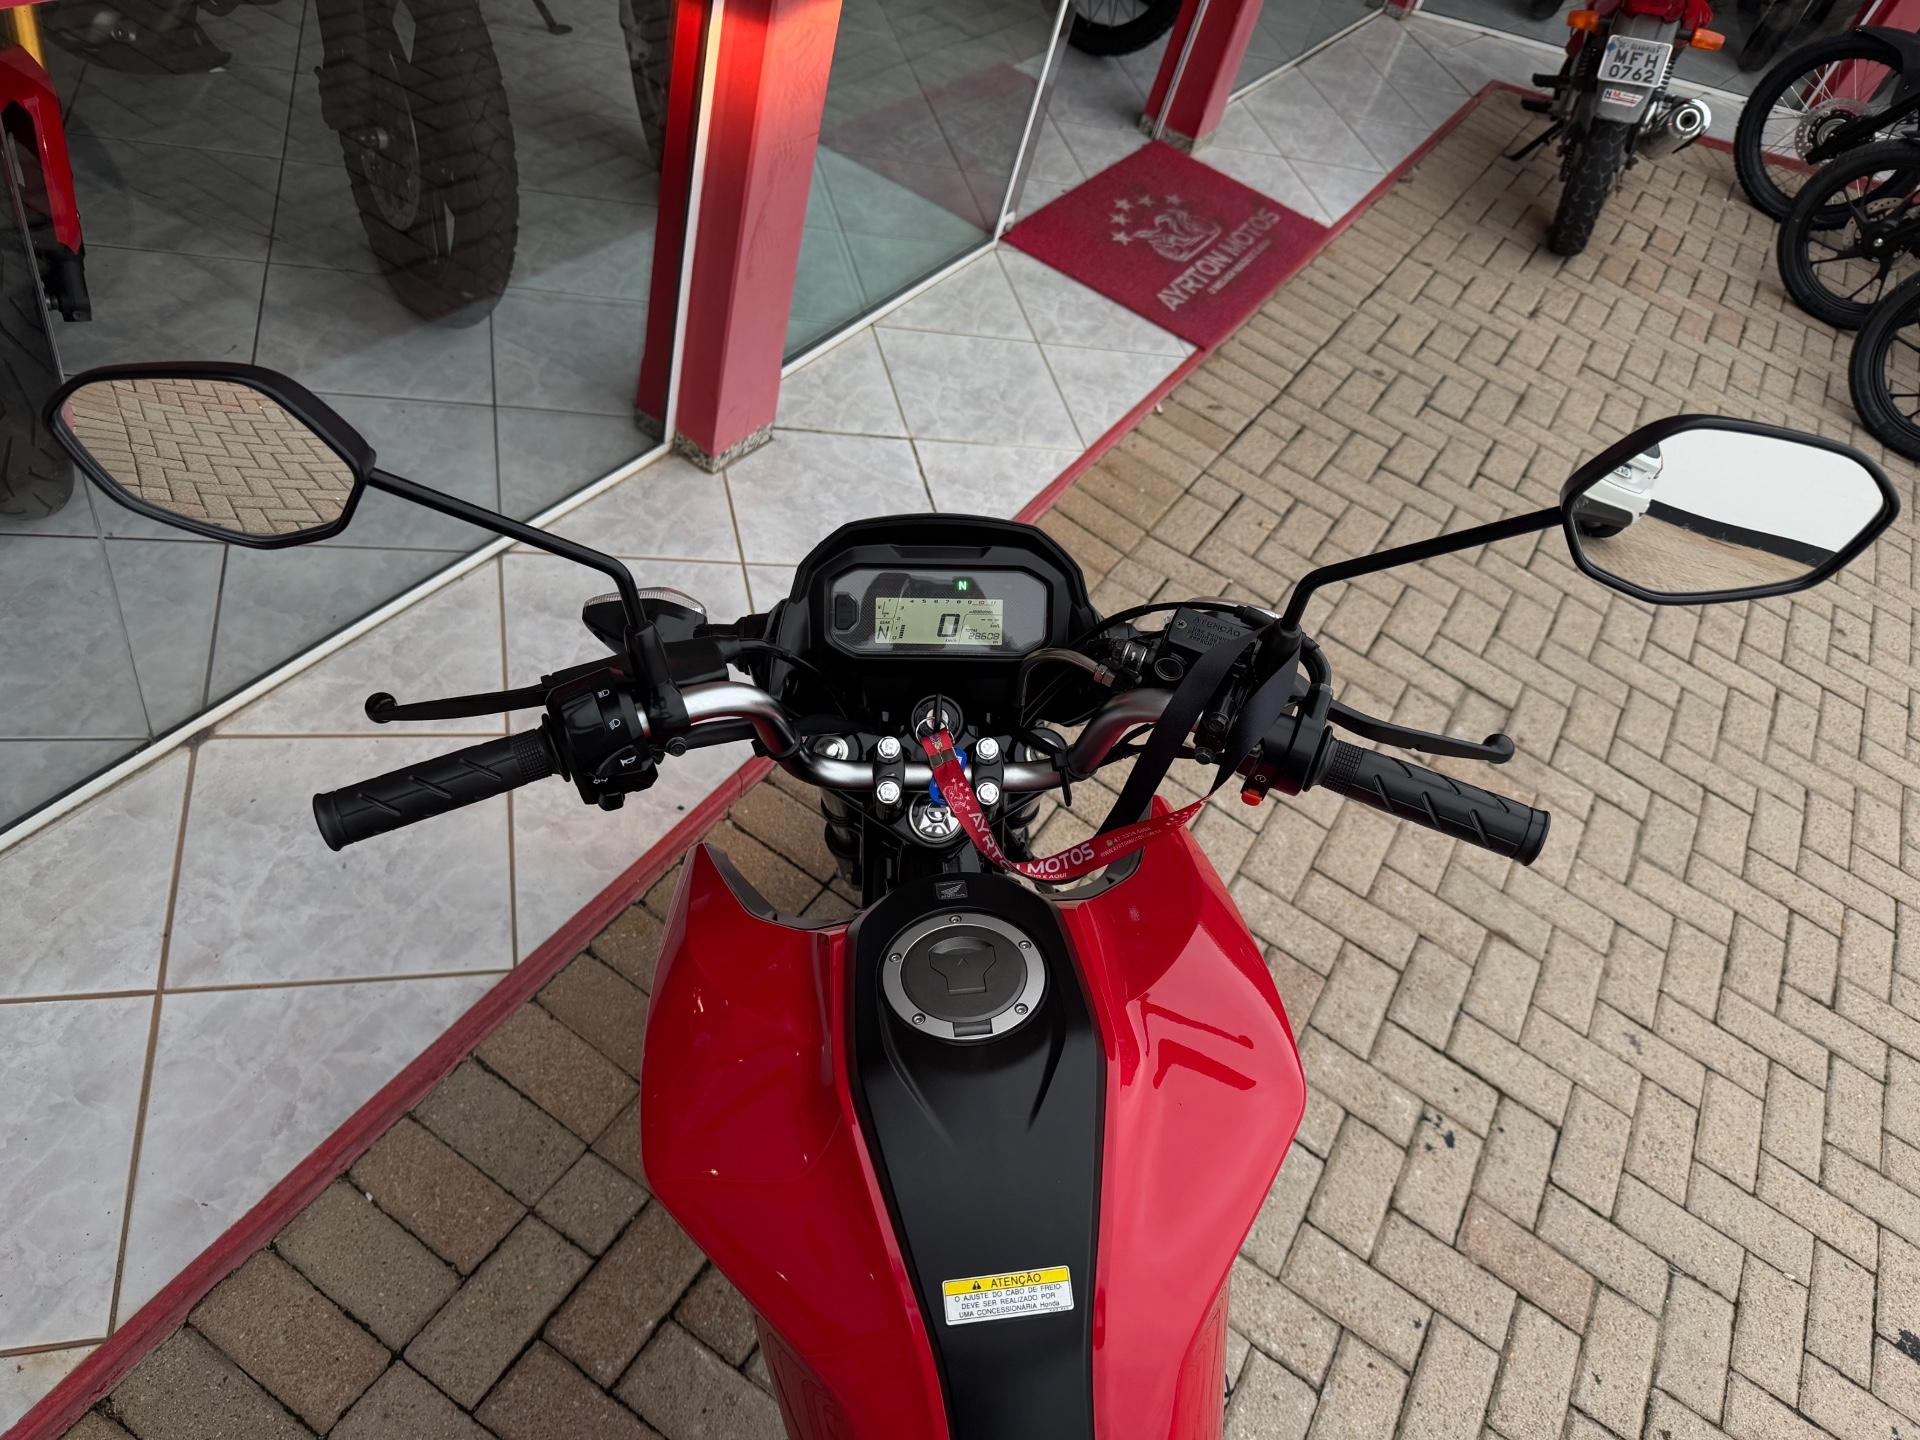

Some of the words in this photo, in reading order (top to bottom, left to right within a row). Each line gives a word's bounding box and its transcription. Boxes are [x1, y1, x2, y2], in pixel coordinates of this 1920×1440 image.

[1614, 49, 1659, 69] MFH
[1608, 64, 1655, 83] 0762
[1157, 249, 1233, 312] AYRTON
[1219, 208, 1281, 257] MOTOS
[959, 581, 967, 590] N
[877, 625, 889, 639] N
[937, 613, 960, 637] 0
[968, 632, 1000, 640] 28608
[1027, 842, 1095, 874] MOTOS
[991, 1272, 1042, 1288] ATENÇÃO
[1001, 1295, 1037, 1305] REALIZADO
[959, 1310, 974, 1318] UMA
[977, 1303, 1037, 1316] CONCESSIONÁRIA
